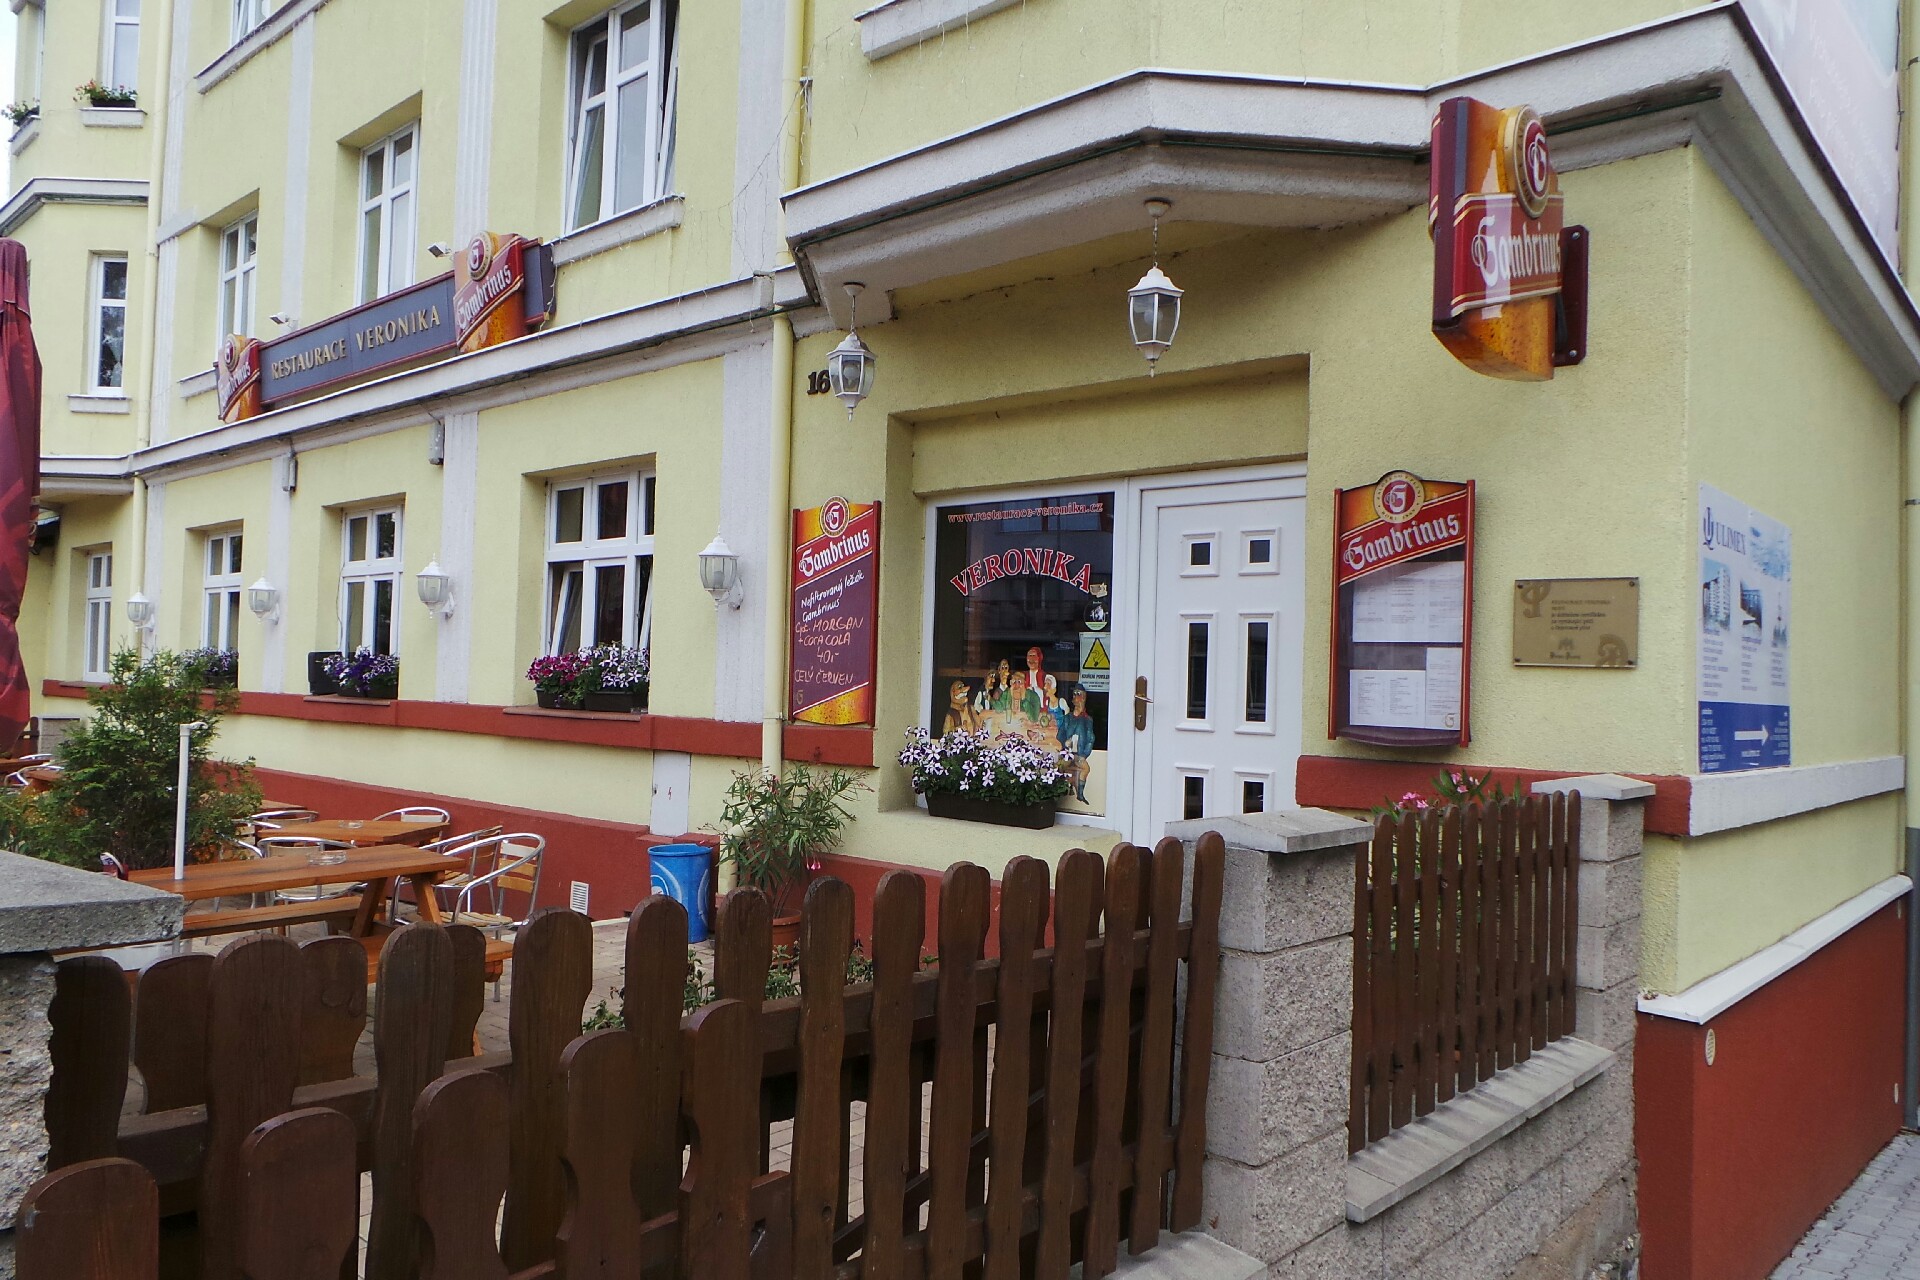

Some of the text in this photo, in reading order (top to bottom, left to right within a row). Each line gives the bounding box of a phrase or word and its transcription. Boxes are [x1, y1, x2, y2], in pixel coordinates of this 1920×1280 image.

[1471, 215, 1561, 288] Gambrinus
[458, 264, 512, 329] Gambrinus
[271, 305, 441, 381] RESTAURACE VERONIKA
[807, 369, 831, 396] 16
[947, 501, 1104, 524] www.restaurace-veronika.cz
[798, 529, 870, 577] Gambrinus
[1343, 513, 1460, 571] Gambrinus
[950, 547, 1092, 597] VERONIKA
[802, 599, 840, 623] Gambrinus
[812, 616, 864, 633] MORGAN
[824, 631, 851, 647] COLA
